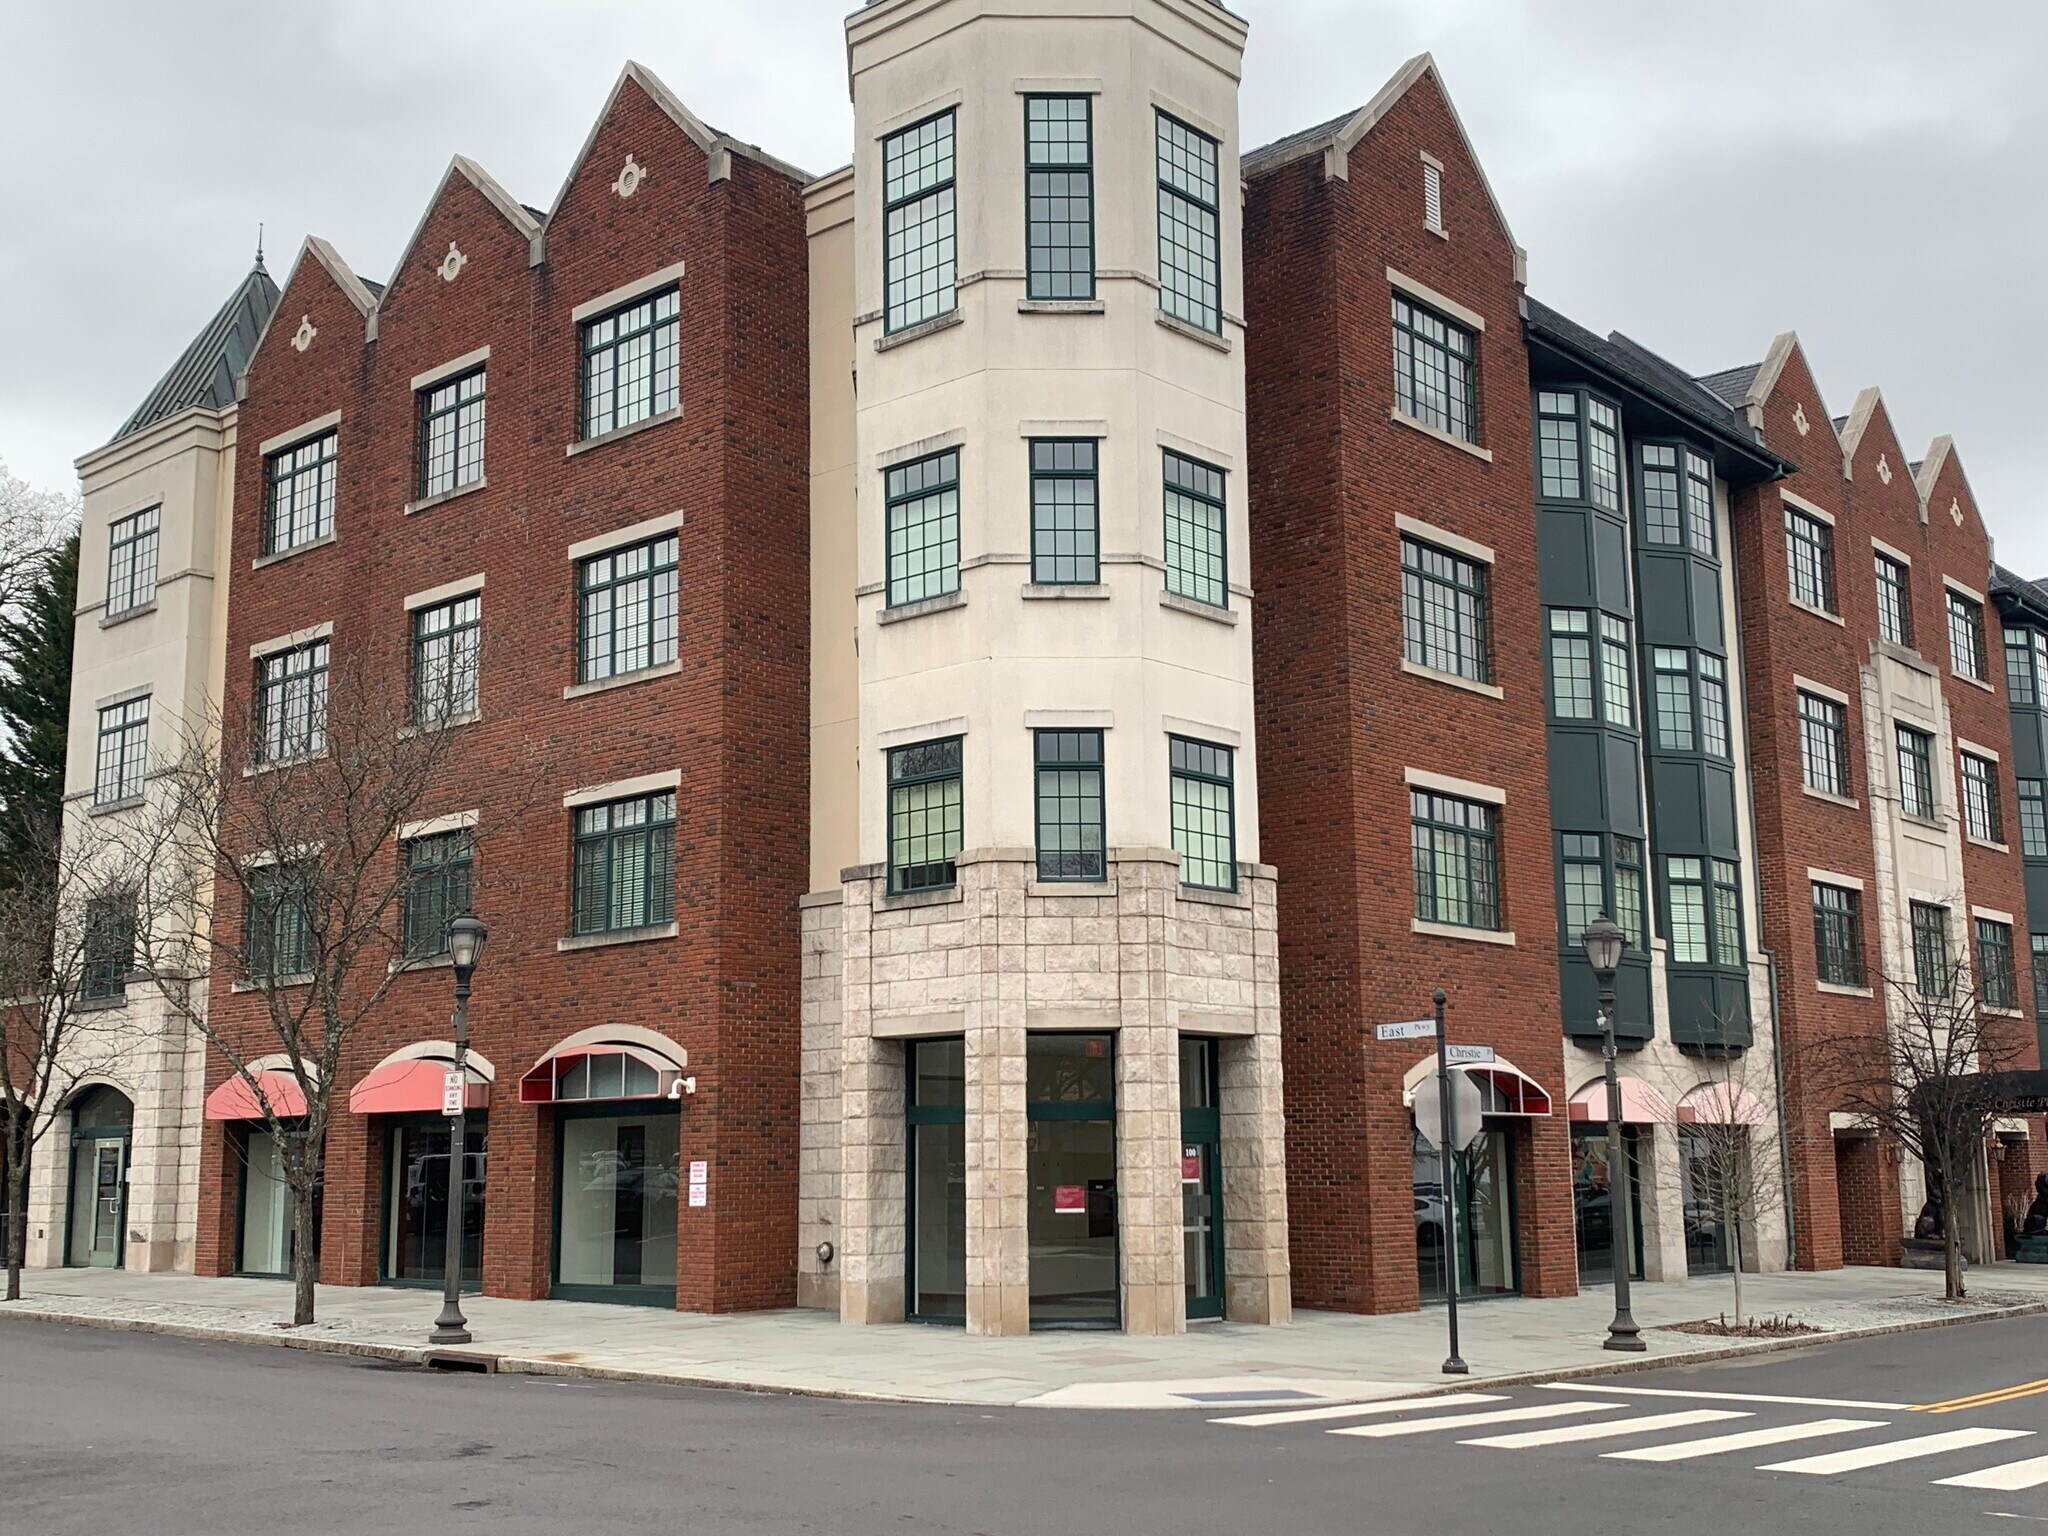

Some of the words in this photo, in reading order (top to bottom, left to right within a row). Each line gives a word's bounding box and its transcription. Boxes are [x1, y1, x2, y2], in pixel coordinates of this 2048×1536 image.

[1381, 1025, 1405, 1038] East
[1449, 1046, 1481, 1058] Christie
[450, 1074, 458, 1084] NO
[1995, 1096, 2035, 1109] Christie
[1185, 1148, 1196, 1157] 100
